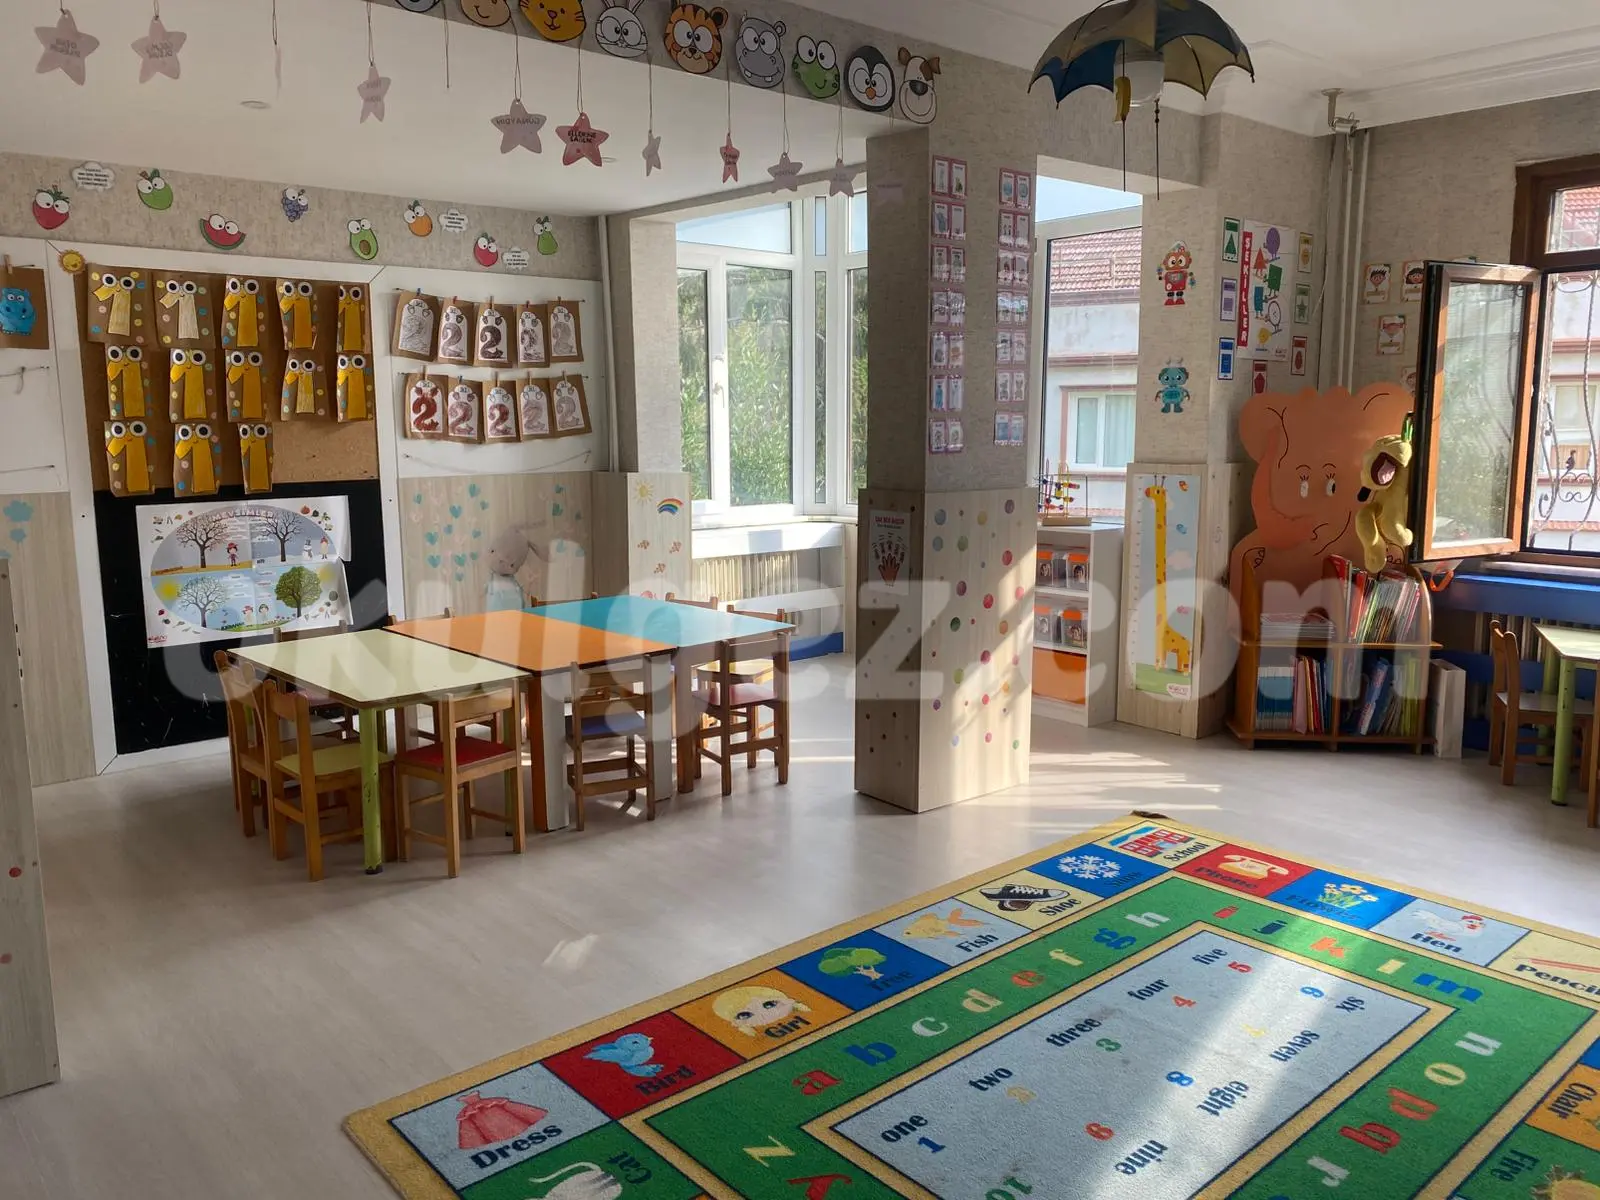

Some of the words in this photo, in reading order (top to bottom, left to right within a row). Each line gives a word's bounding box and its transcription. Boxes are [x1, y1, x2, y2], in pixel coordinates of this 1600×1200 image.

[1163, 842, 1210, 861] School
[1037, 896, 1082, 917] Shoe
[1124, 911, 1171, 928] h
[956, 931, 998, 954] Fish
[1093, 927, 1137, 950] g
[1410, 932, 1463, 953] Hen
[1049, 947, 1084, 968] f
[1192, 946, 1228, 966] five
[1227, 960, 1253, 974] 5
[1127, 976, 1171, 1001] four
[1412, 972, 1483, 1003] m
[962, 988, 1004, 1013] d
[1171, 994, 1196, 1008] 4
[1335, 994, 1366, 1014] six
[764, 1014, 811, 1039] Girl
[1045, 1017, 1102, 1048] three
[843, 1042, 897, 1067] b
[1095, 1037, 1122, 1052] 3
[1269, 1029, 1321, 1062] seven
[635, 1065, 697, 1098] Bird
[792, 1069, 843, 1096] a
[968, 1067, 1013, 1092] two
[1166, 1070, 1195, 1087] 8
[1196, 1080, 1250, 1117] eight
[1548, 1081, 1599, 1120] Chair
[880, 1113, 929, 1143] one
[470, 1122, 564, 1170] Dress
[917, 1136, 946, 1154] 1
[1113, 1139, 1169, 1175] nine
[607, 1151, 652, 1183] Cat
